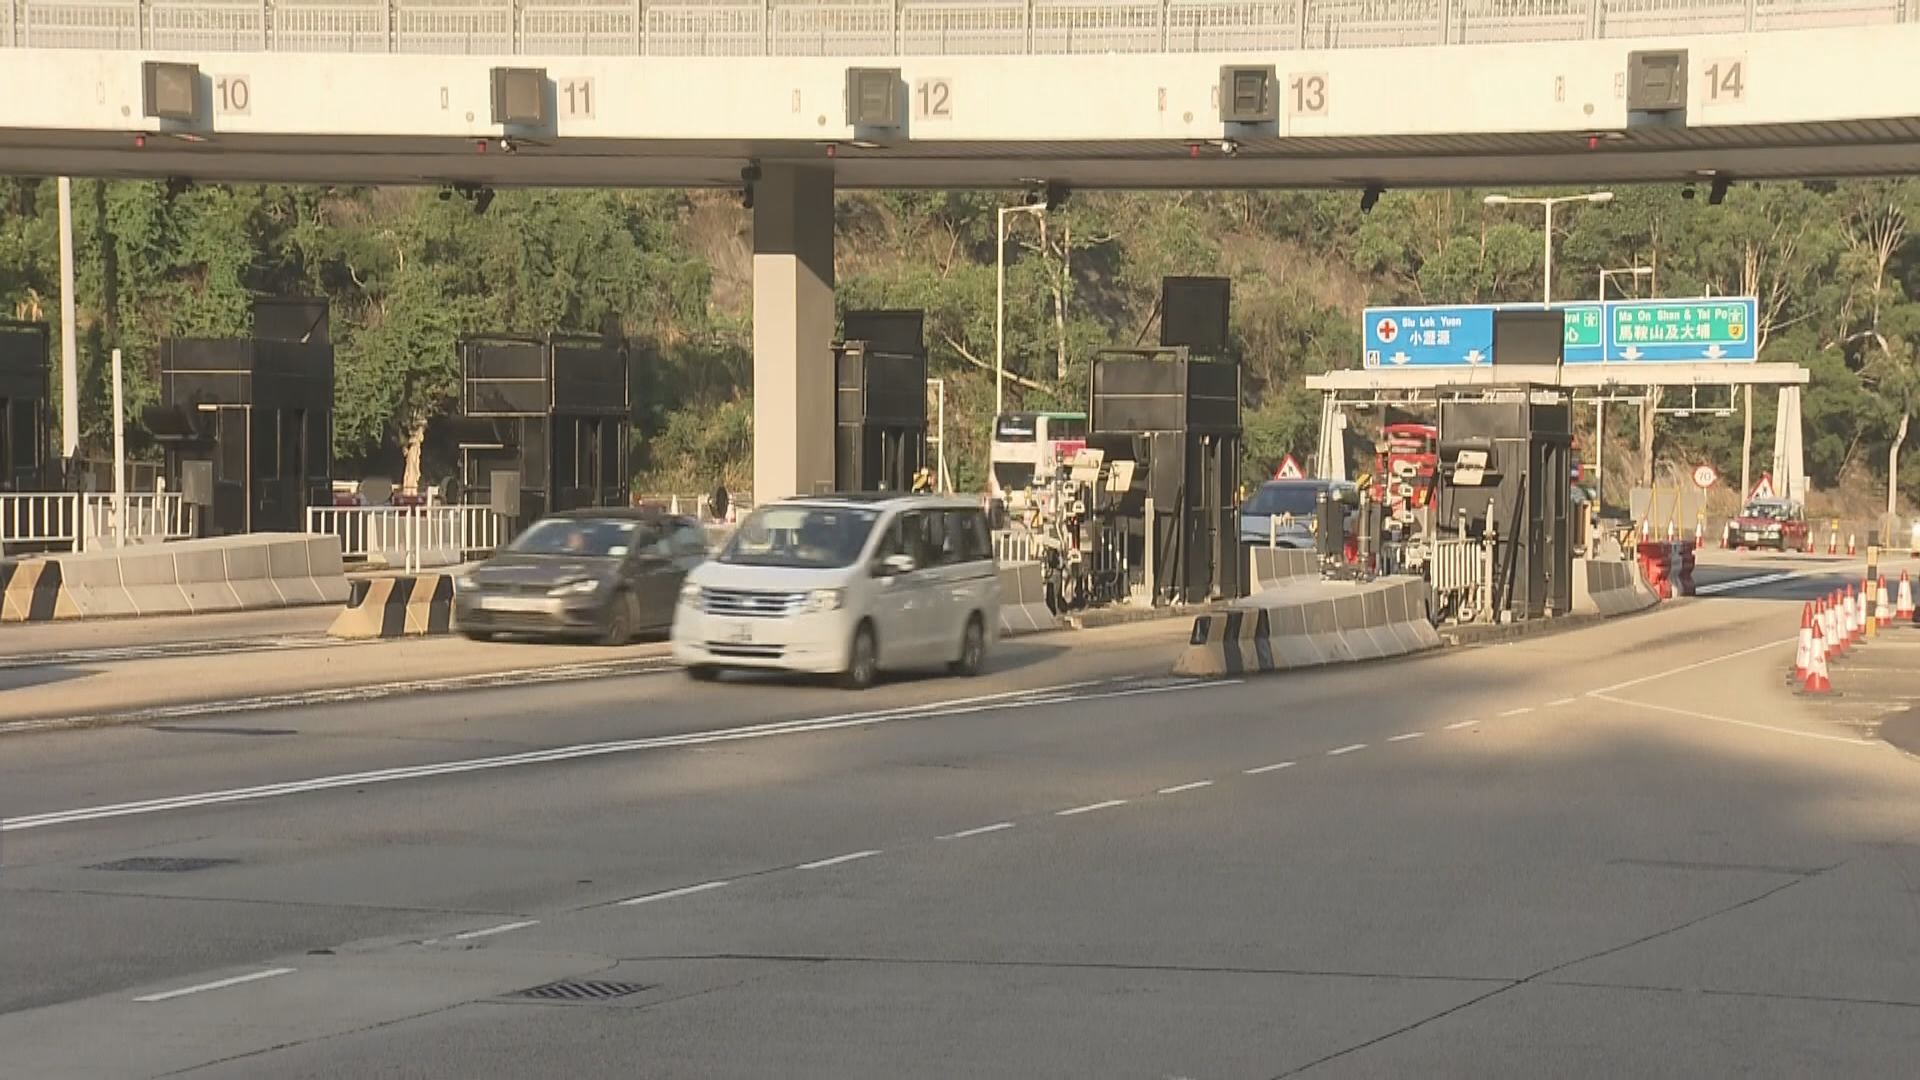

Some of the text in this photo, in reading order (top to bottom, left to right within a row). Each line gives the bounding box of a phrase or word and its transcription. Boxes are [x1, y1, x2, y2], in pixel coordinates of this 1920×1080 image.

[216, 79, 249, 110] 10
[564, 81, 592, 113] 11
[1291, 77, 1325, 112] 13
[1705, 62, 1744, 99] 14
[917, 81, 950, 115] 12
[1619, 310, 1632, 322] Ma
[1637, 309, 1651, 321] On
[1657, 309, 1680, 321] Shan
[1715, 307, 1728, 320] Po
